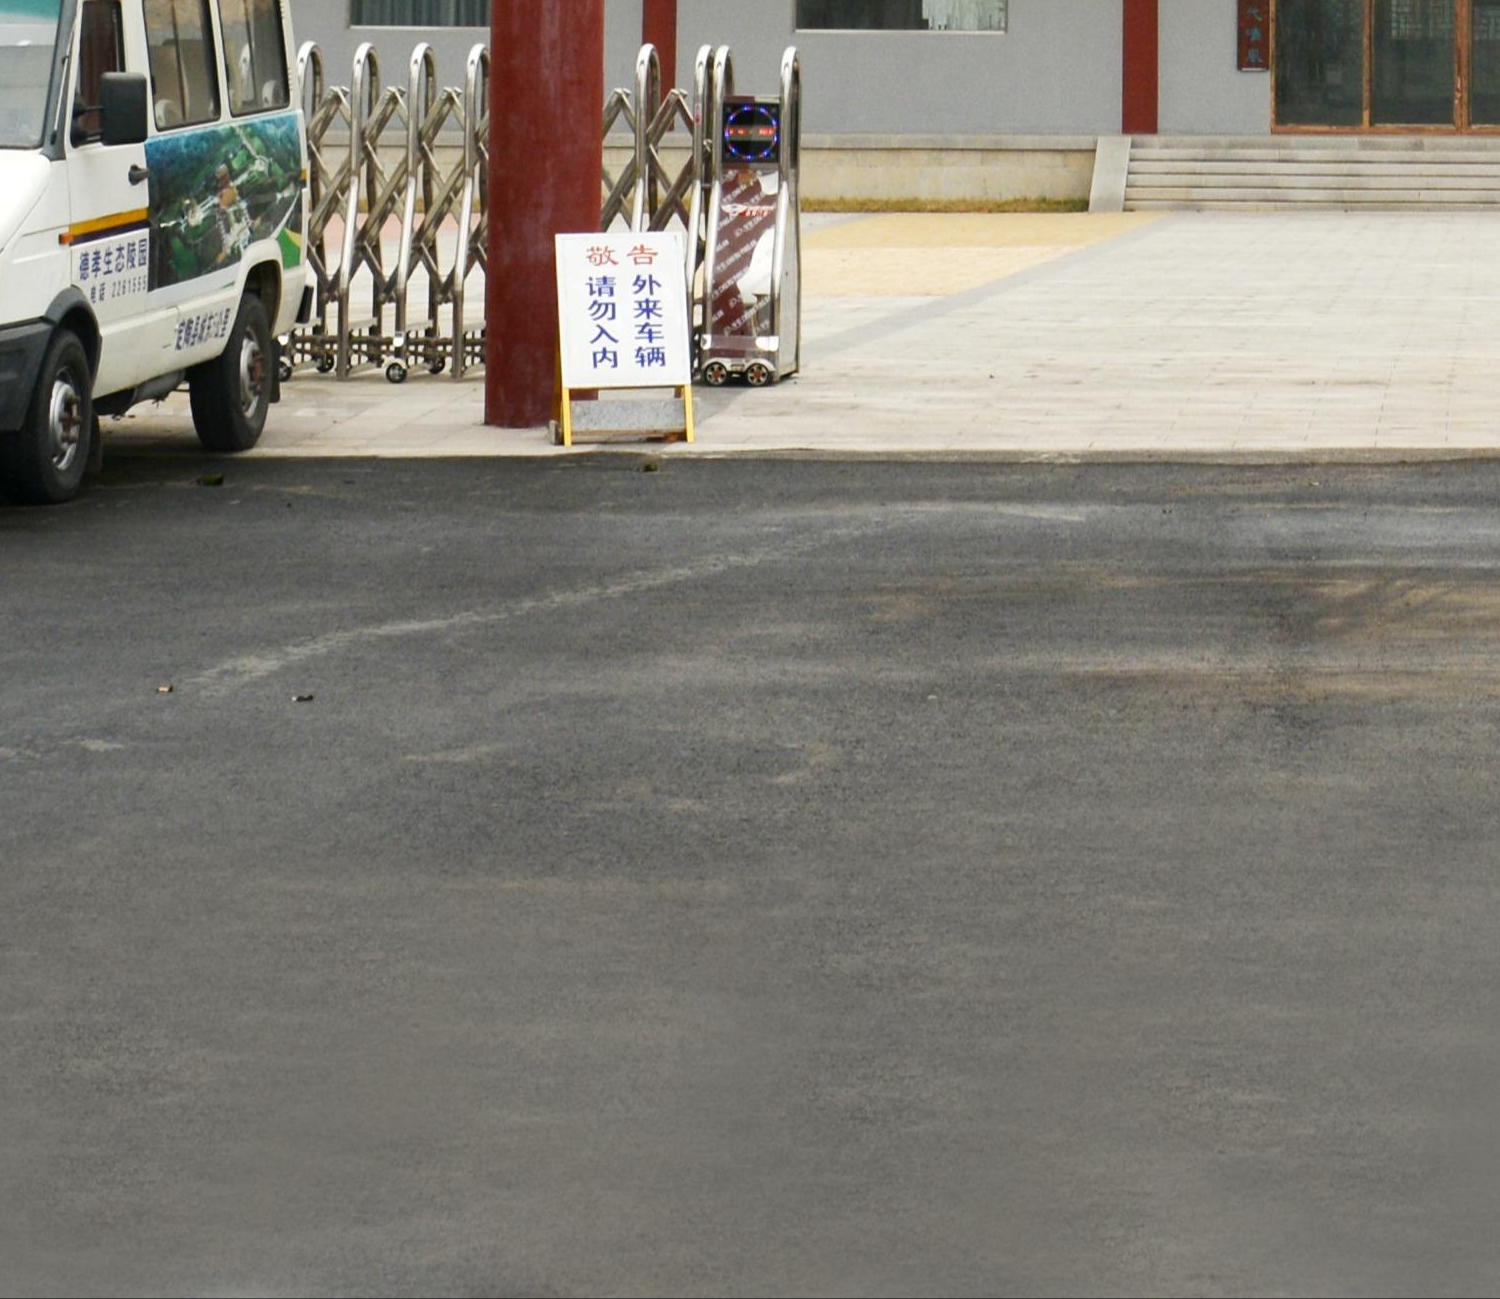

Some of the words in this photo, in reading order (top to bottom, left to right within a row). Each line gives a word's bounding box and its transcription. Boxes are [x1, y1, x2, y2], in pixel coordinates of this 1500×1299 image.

[78, 237, 148, 281] 德孝生态陵园
[585, 243, 659, 267] 敬告
[584, 274, 620, 370] 请勿入内
[631, 273, 667, 369] 外来车辆
